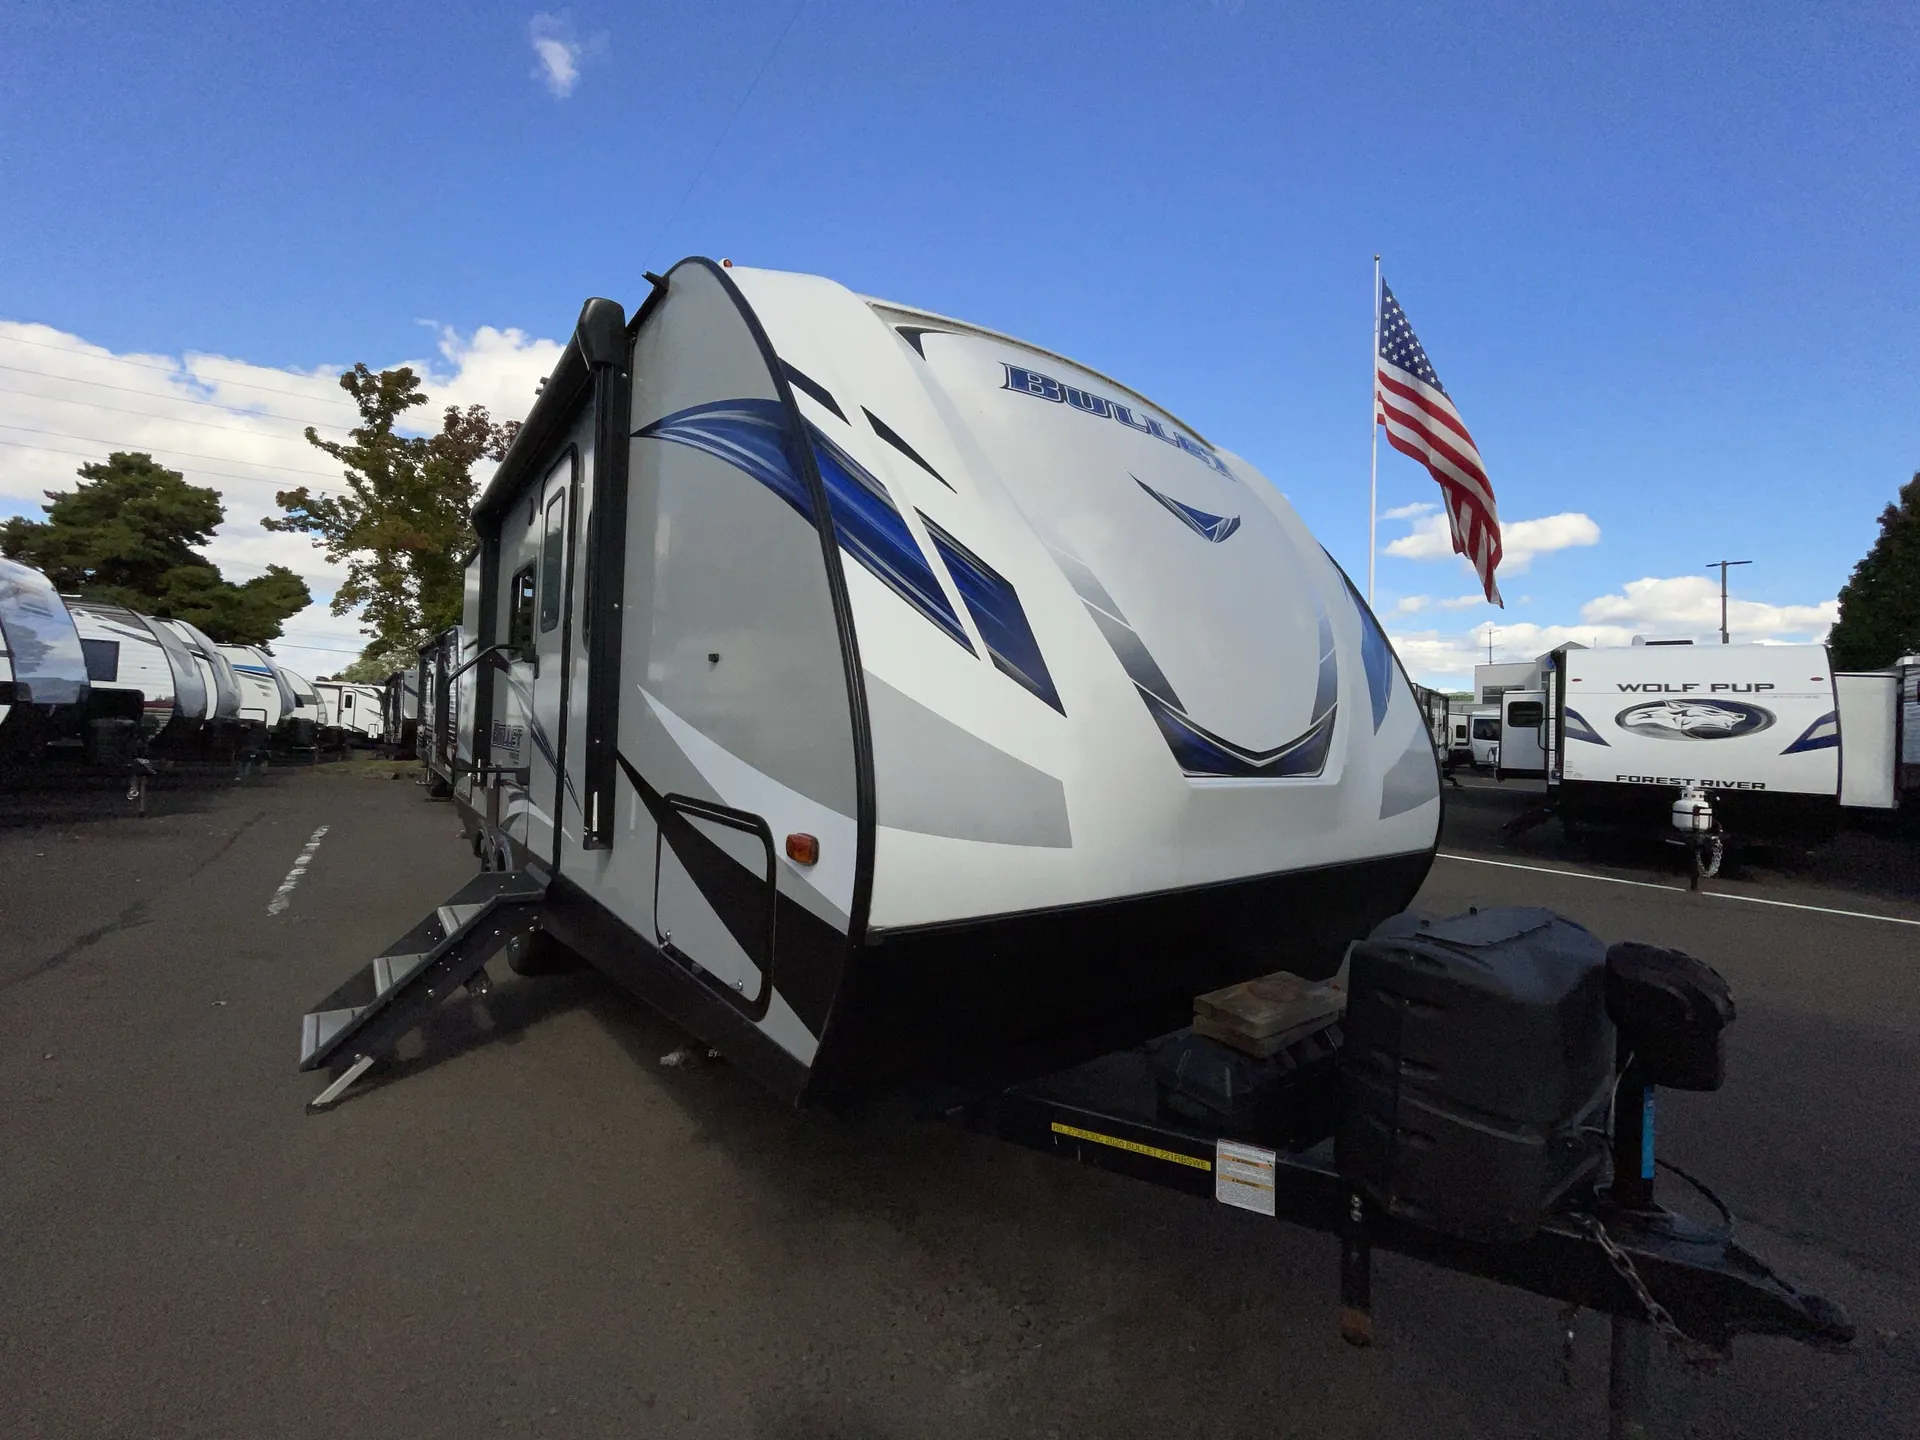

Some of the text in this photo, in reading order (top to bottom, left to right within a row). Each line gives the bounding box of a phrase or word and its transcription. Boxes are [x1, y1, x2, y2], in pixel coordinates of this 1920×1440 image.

[997, 361, 1236, 482] BULLET
[1616, 683, 1775, 693] WOLF PUP
[1615, 774, 1766, 790] FOREST RIVER
[1105, 1136, 1125, 1148] 2020
[1126, 1142, 1158, 1156] BULLET
